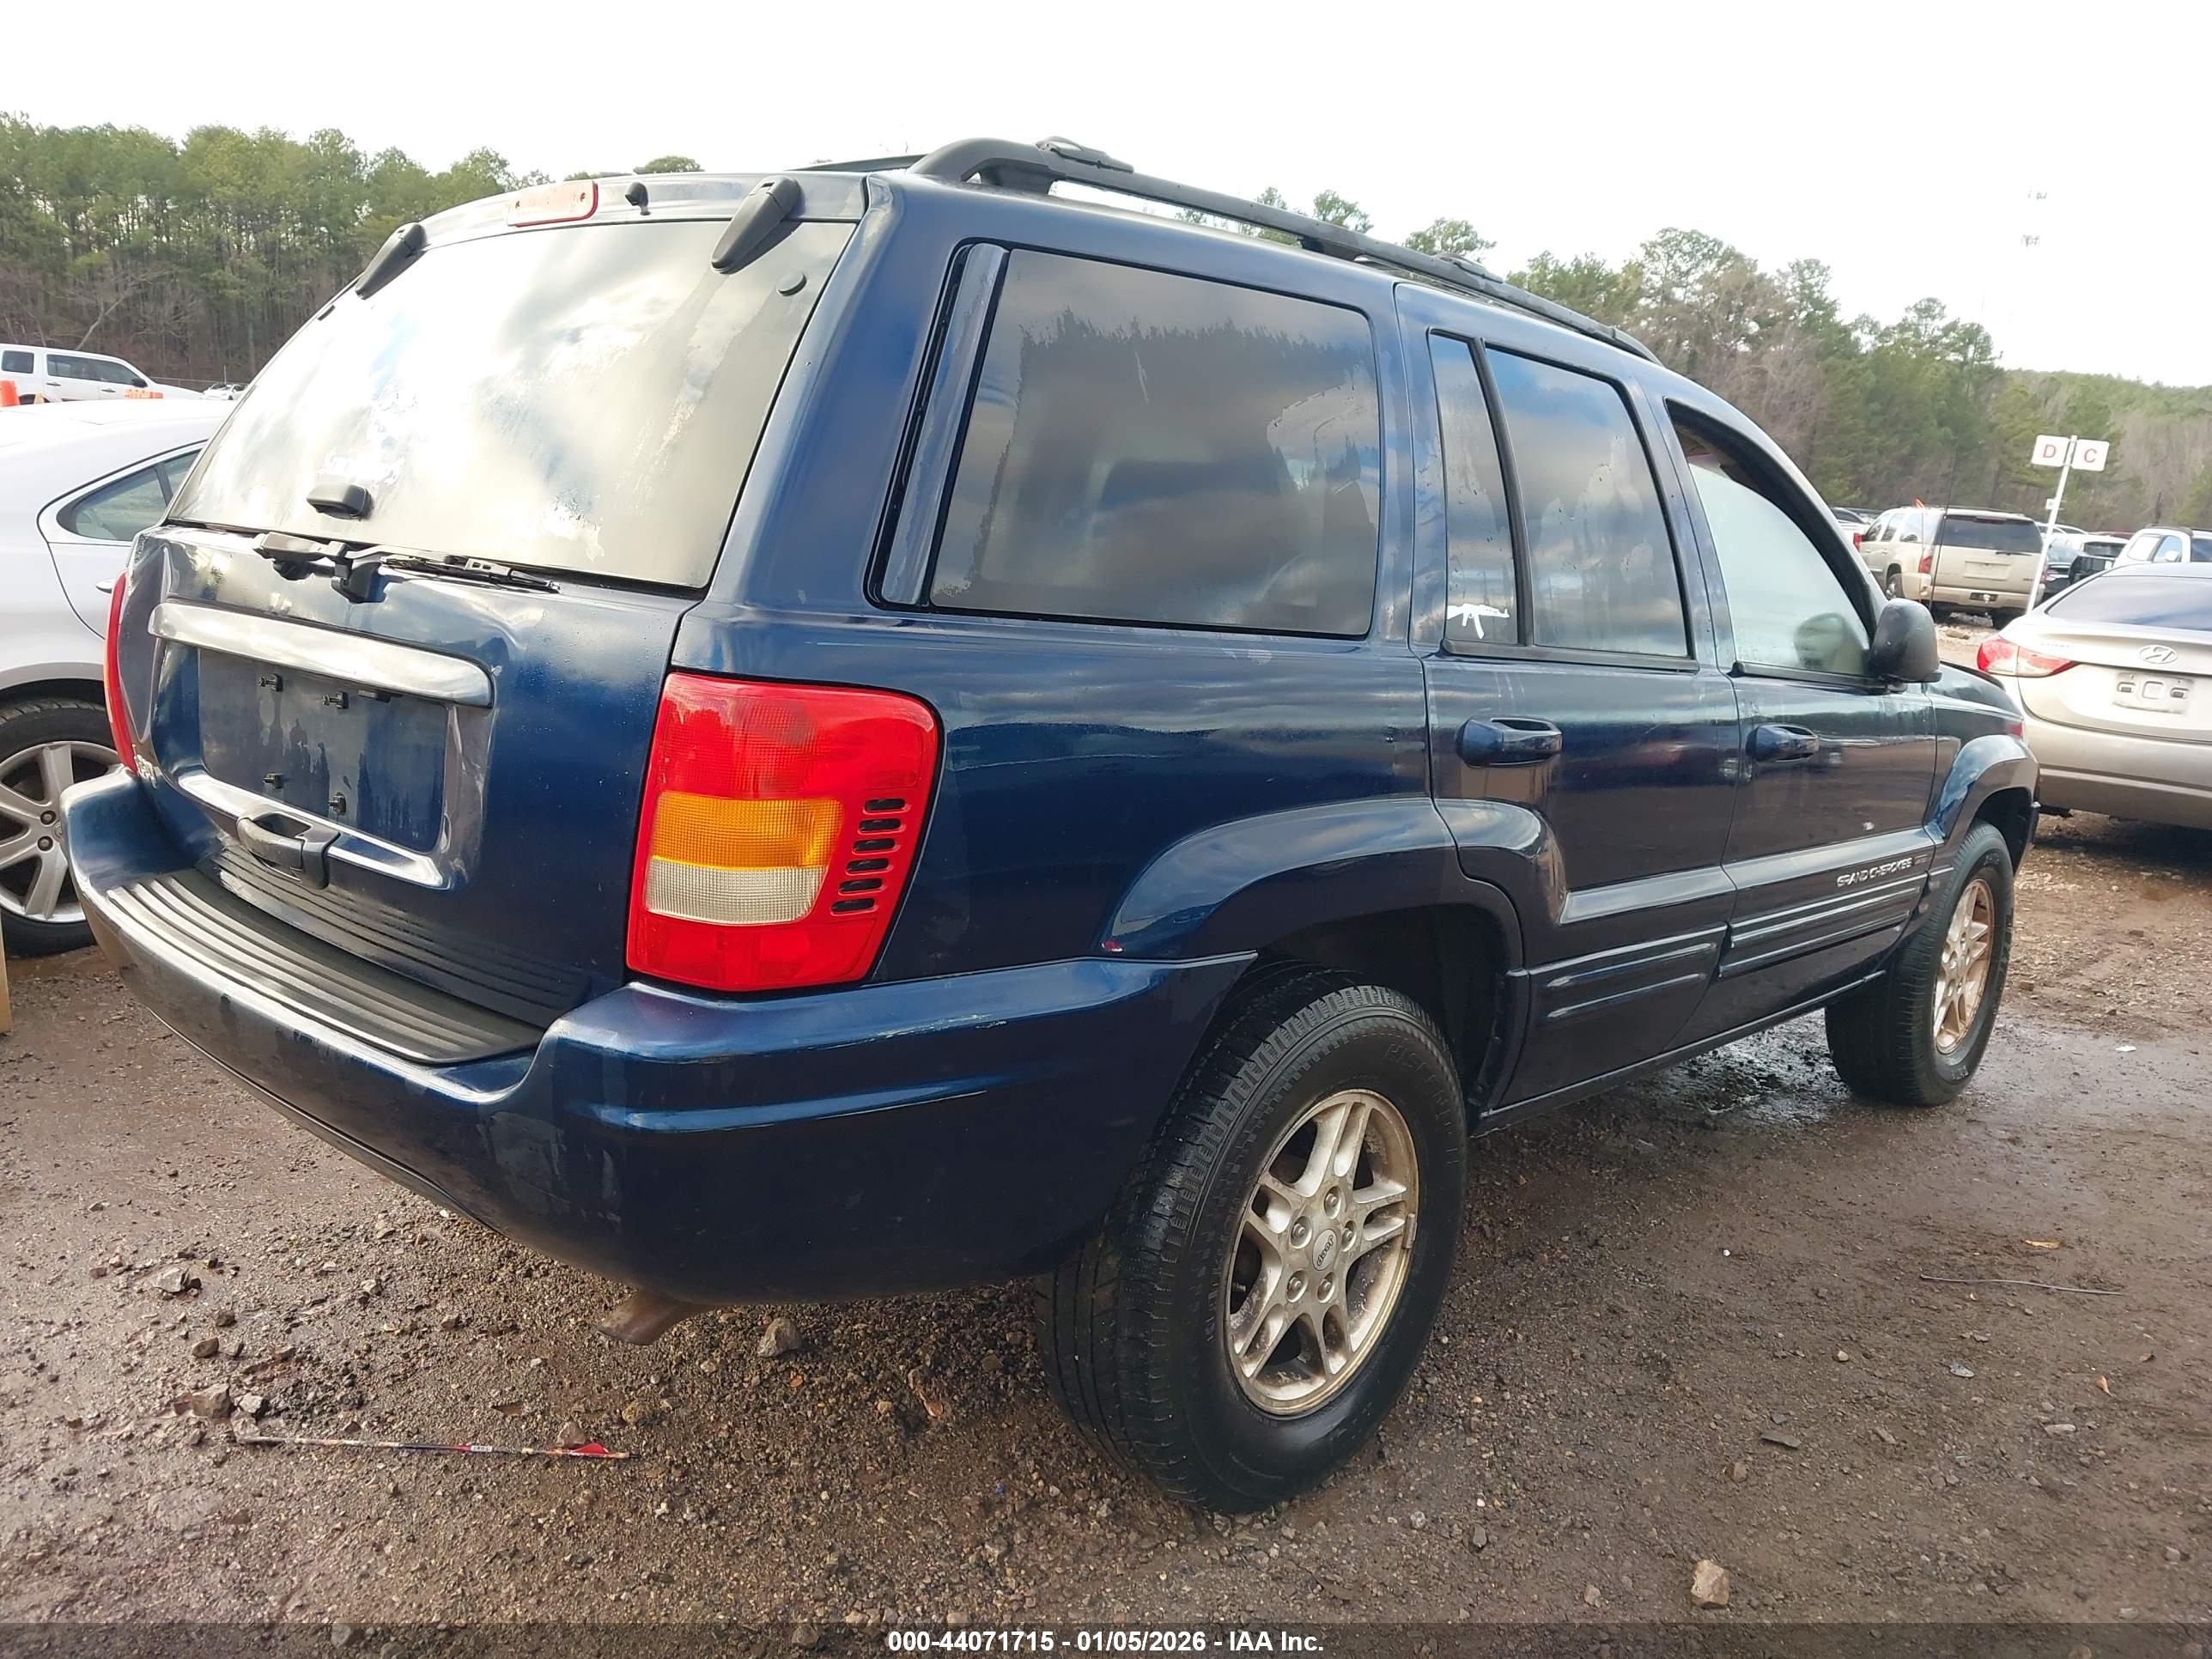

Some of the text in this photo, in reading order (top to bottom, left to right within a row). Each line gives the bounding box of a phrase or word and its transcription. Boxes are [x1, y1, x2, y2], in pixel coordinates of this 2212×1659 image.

[2042, 444, 2057, 459] D
[2083, 448, 2098, 463] C
[1869, 857, 1913, 879] CHEROKEE
[1316, 1234, 1334, 1267] Jeep
